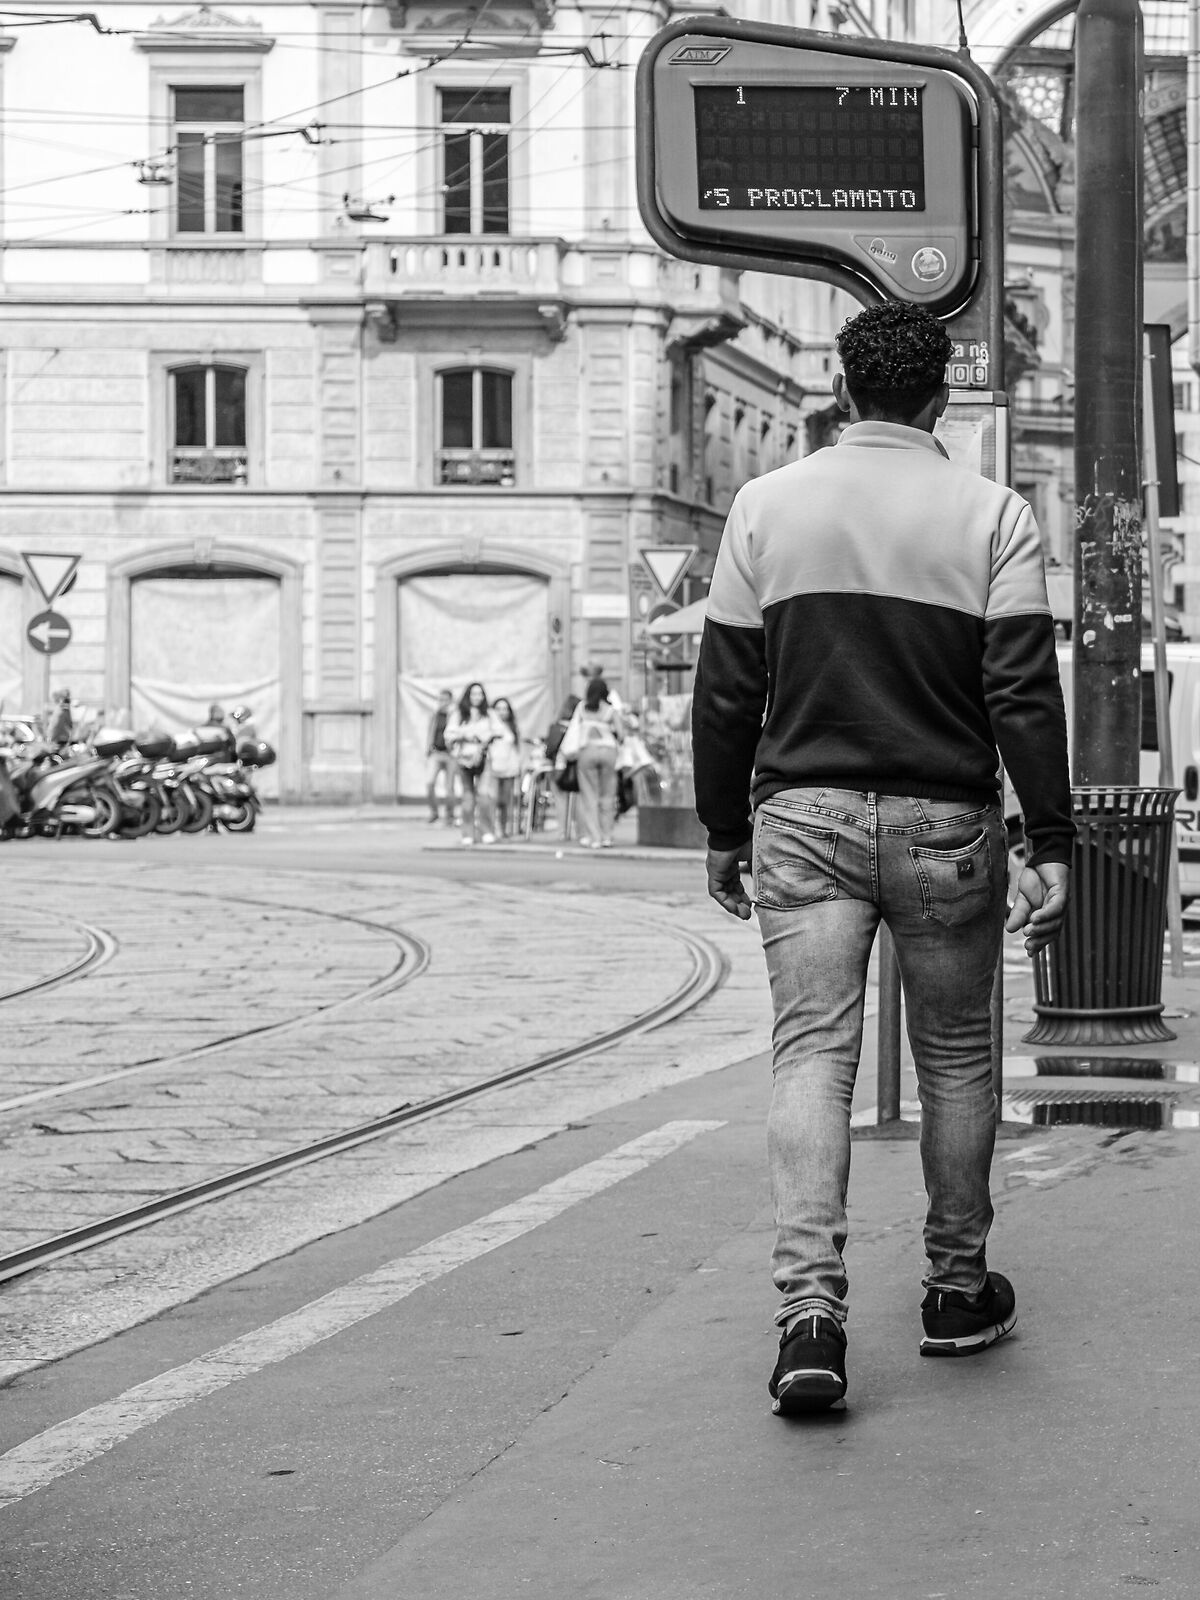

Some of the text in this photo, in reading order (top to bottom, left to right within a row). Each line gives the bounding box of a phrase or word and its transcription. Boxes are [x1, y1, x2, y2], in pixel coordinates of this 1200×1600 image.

[685, 50, 709, 59] ATM
[736, 86, 918, 106] 1 7 MIN
[747, 188, 916, 208] PROCLAMATO
